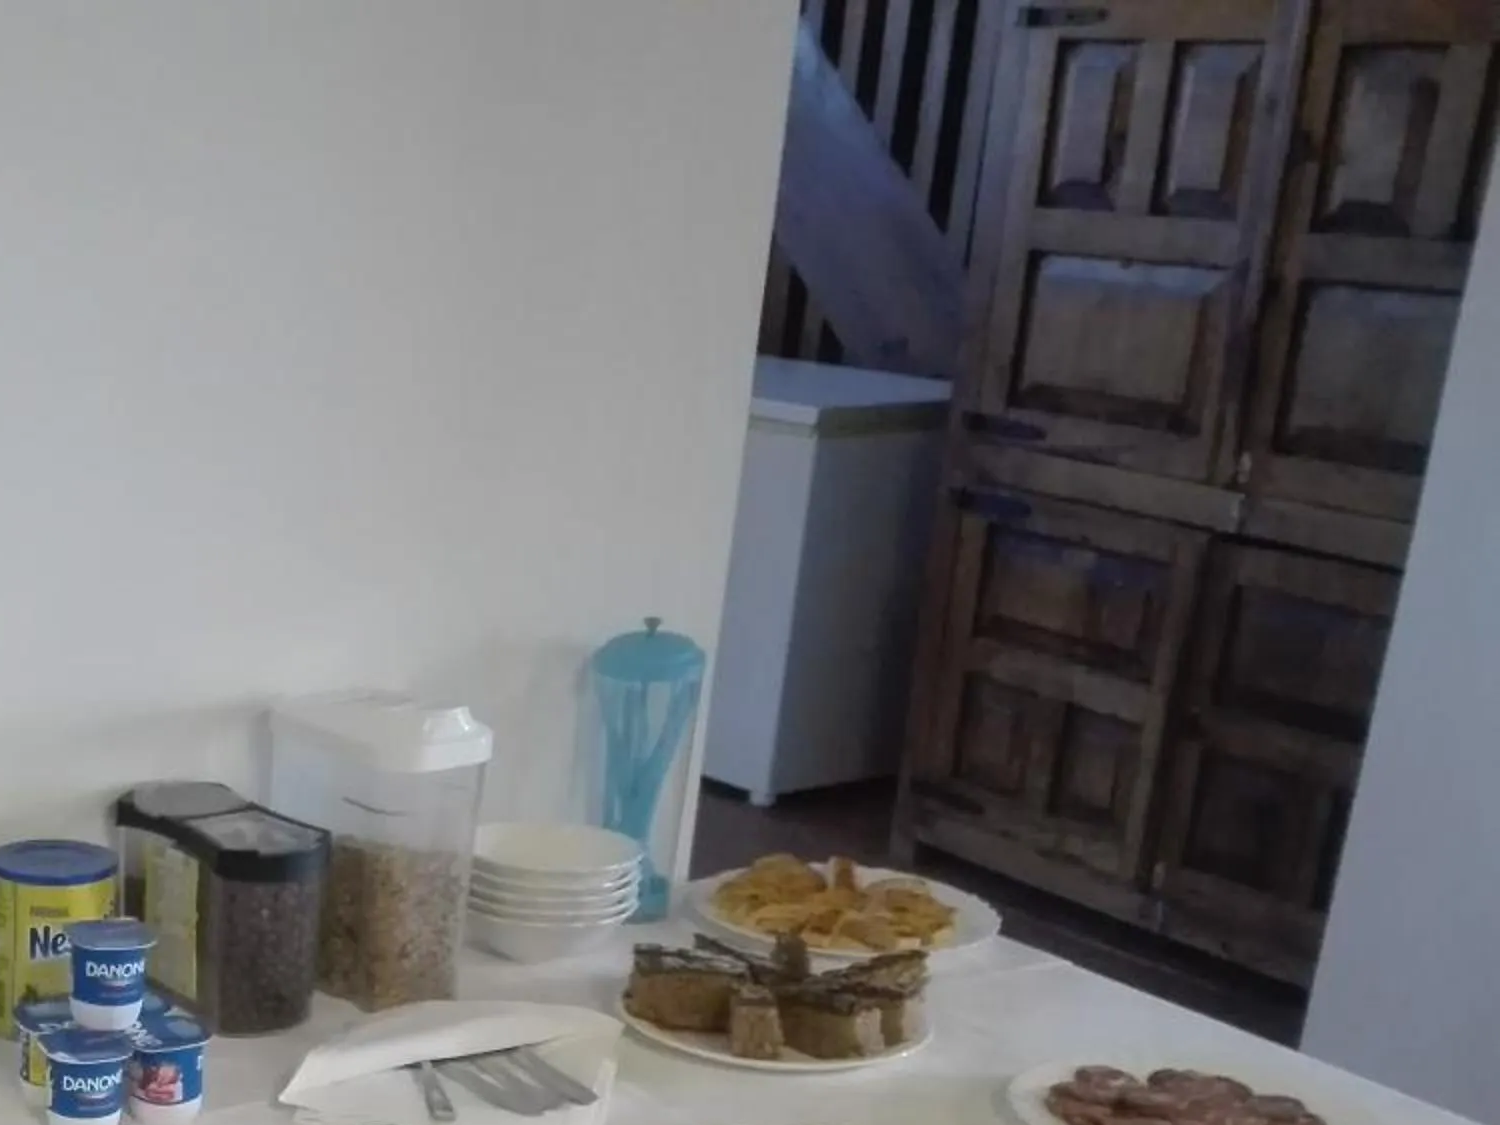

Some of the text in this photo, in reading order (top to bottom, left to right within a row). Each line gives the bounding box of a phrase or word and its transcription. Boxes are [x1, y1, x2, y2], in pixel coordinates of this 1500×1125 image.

[29, 925, 72, 960] Ne
[85, 957, 146, 978] DANON
[62, 1067, 124, 1092] DANON
